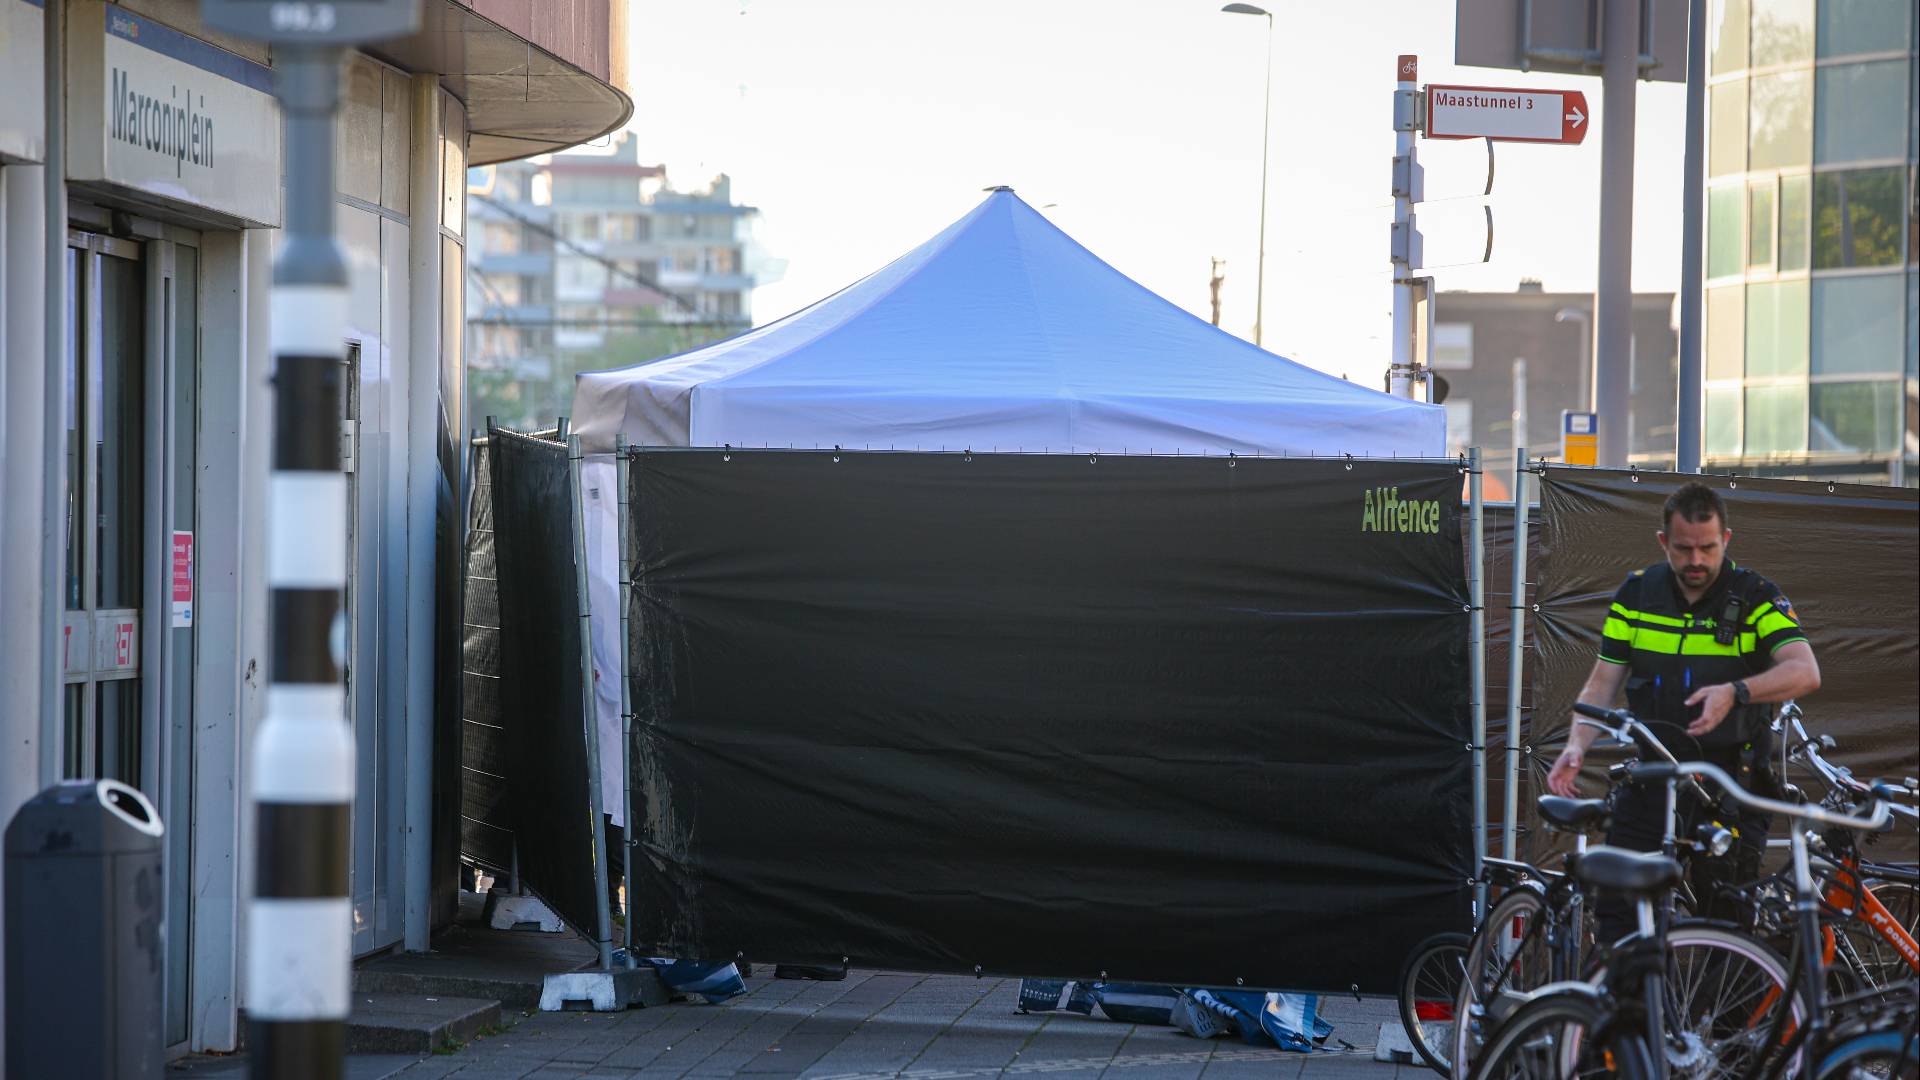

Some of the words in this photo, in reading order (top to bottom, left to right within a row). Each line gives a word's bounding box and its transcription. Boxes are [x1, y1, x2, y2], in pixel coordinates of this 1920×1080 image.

[1436, 92, 1521, 109] Maastunnel
[1526, 99, 1533, 109] 3
[112, 67, 214, 178] Marconiplein
[1362, 487, 1440, 533] Allfence
[1885, 926, 1919, 962] DONKEY
